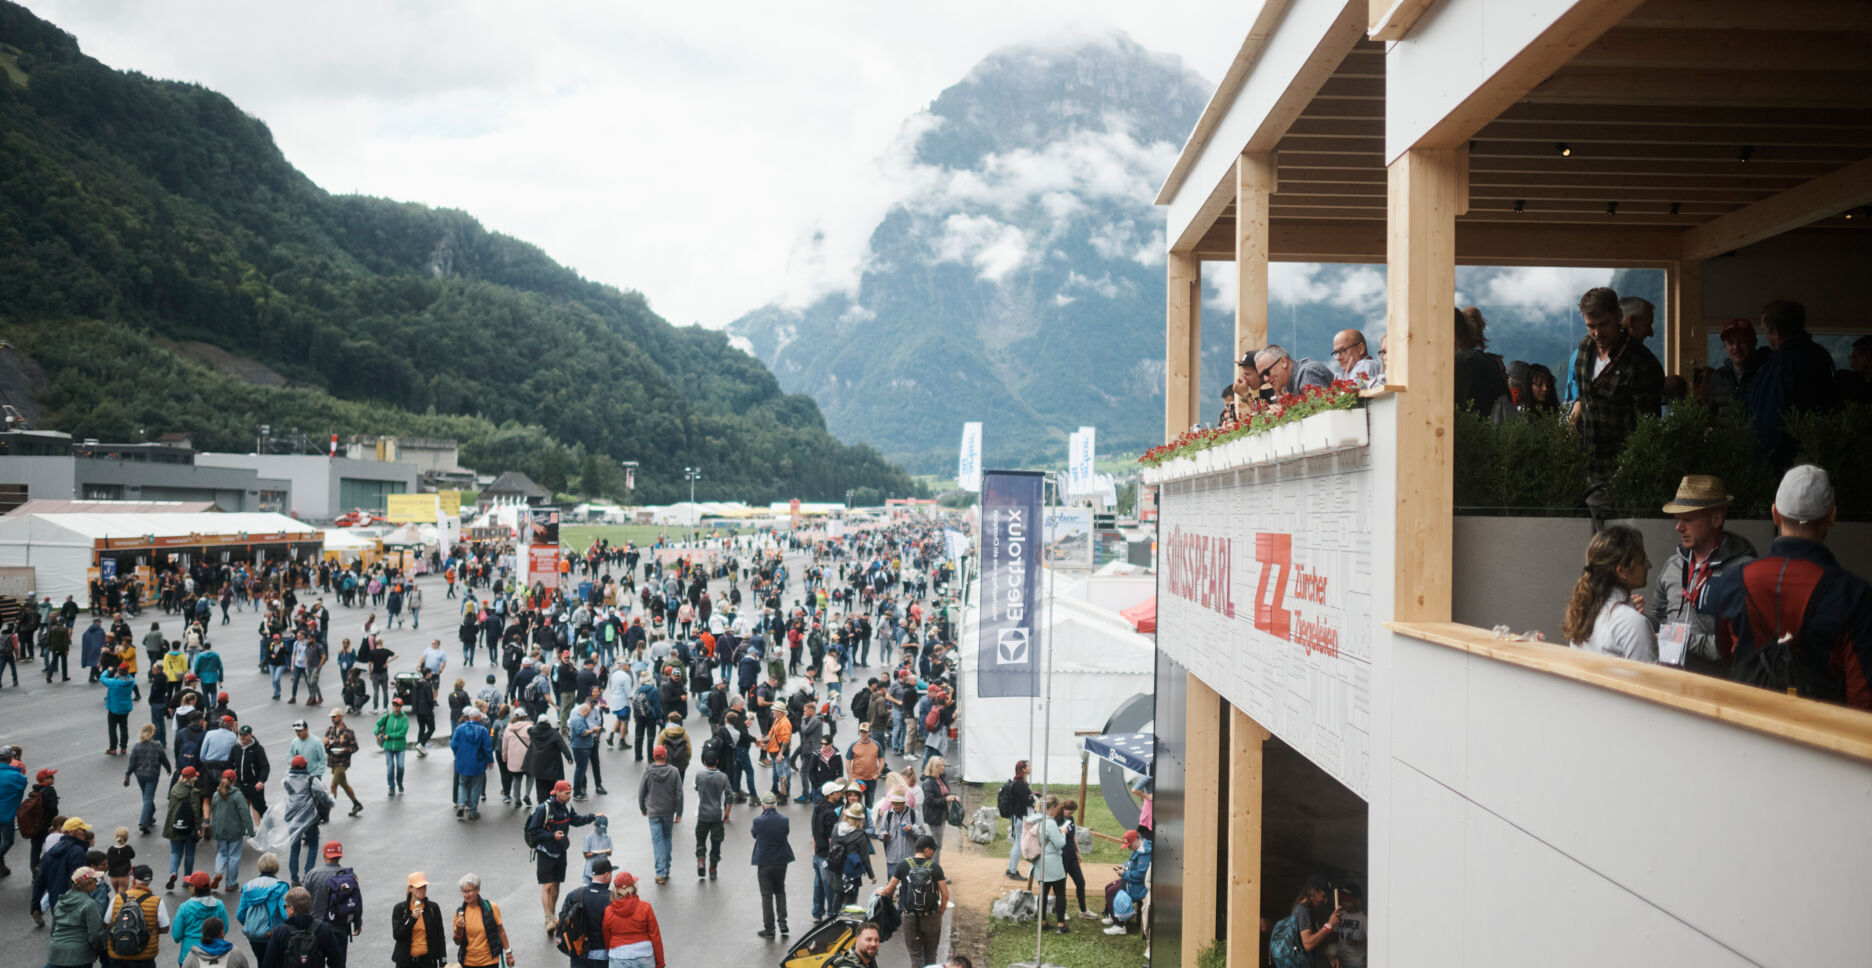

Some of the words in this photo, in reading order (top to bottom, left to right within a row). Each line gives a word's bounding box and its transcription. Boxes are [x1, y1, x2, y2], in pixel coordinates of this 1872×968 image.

[1166, 525, 1235, 619] SWISSPEARL
[1294, 563, 1327, 605] Zürcher
[1294, 610, 1339, 658] Ziegeleien
